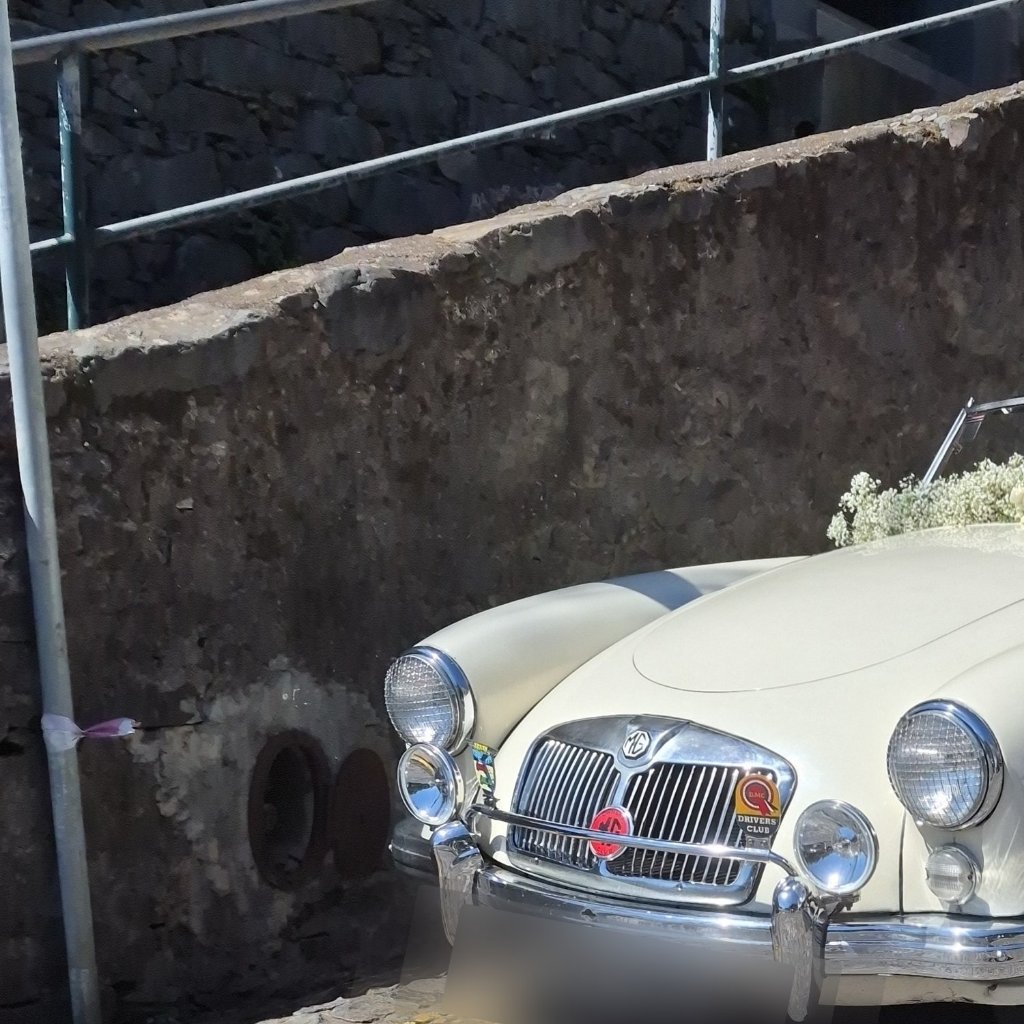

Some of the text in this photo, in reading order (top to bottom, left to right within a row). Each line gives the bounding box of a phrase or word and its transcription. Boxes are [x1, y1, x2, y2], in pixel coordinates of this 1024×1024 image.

[624, 732, 647, 755] MG
[738, 815, 777, 826] DRIVERS
[746, 825, 770, 834] CLUB
